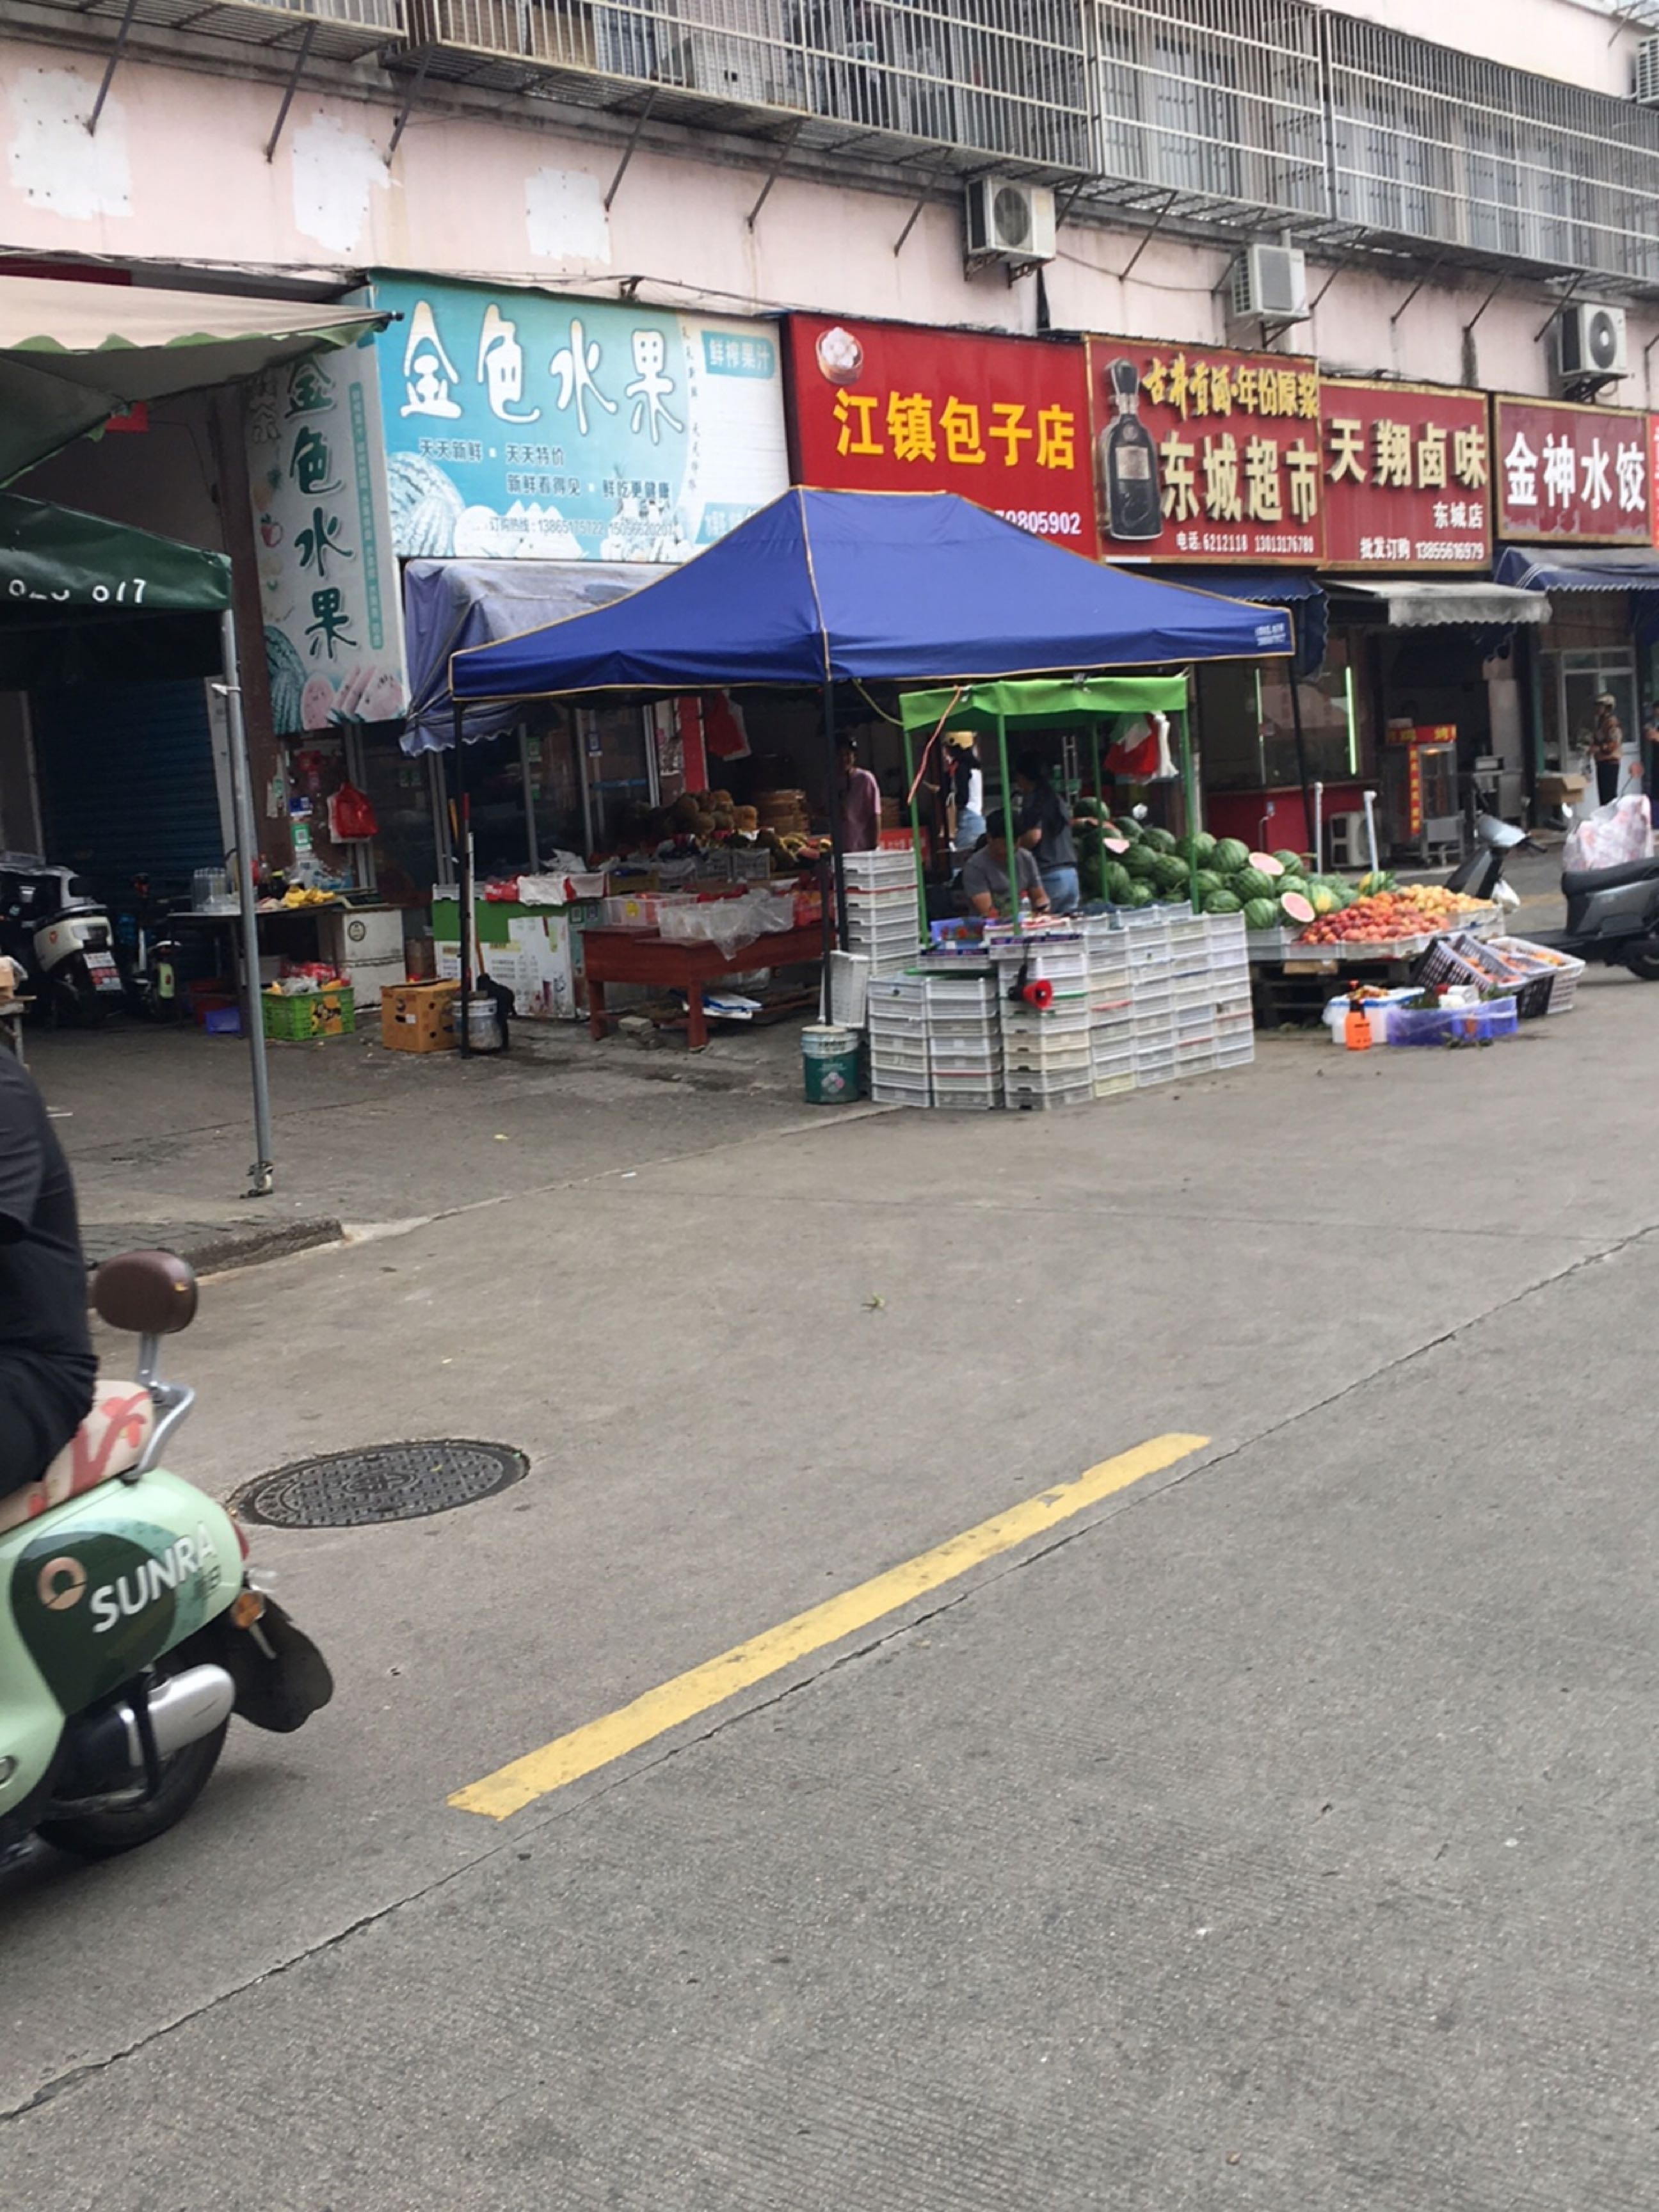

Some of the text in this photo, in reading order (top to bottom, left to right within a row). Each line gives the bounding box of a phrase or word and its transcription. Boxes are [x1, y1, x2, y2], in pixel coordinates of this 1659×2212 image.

[399, 300, 684, 445] 金色水果
[833, 388, 1075, 470] 江镇包子店
[1326, 419, 1487, 490] 天翔卤味
[285, 355, 357, 659] 金色水果
[1161, 430, 1318, 524] 东城超市
[1505, 431, 1646, 512] 金神水饺
[994, 509, 1082, 534] 805902
[1432, 501, 1484, 529] 东城店
[90, 1521, 218, 1633] SUNRA
